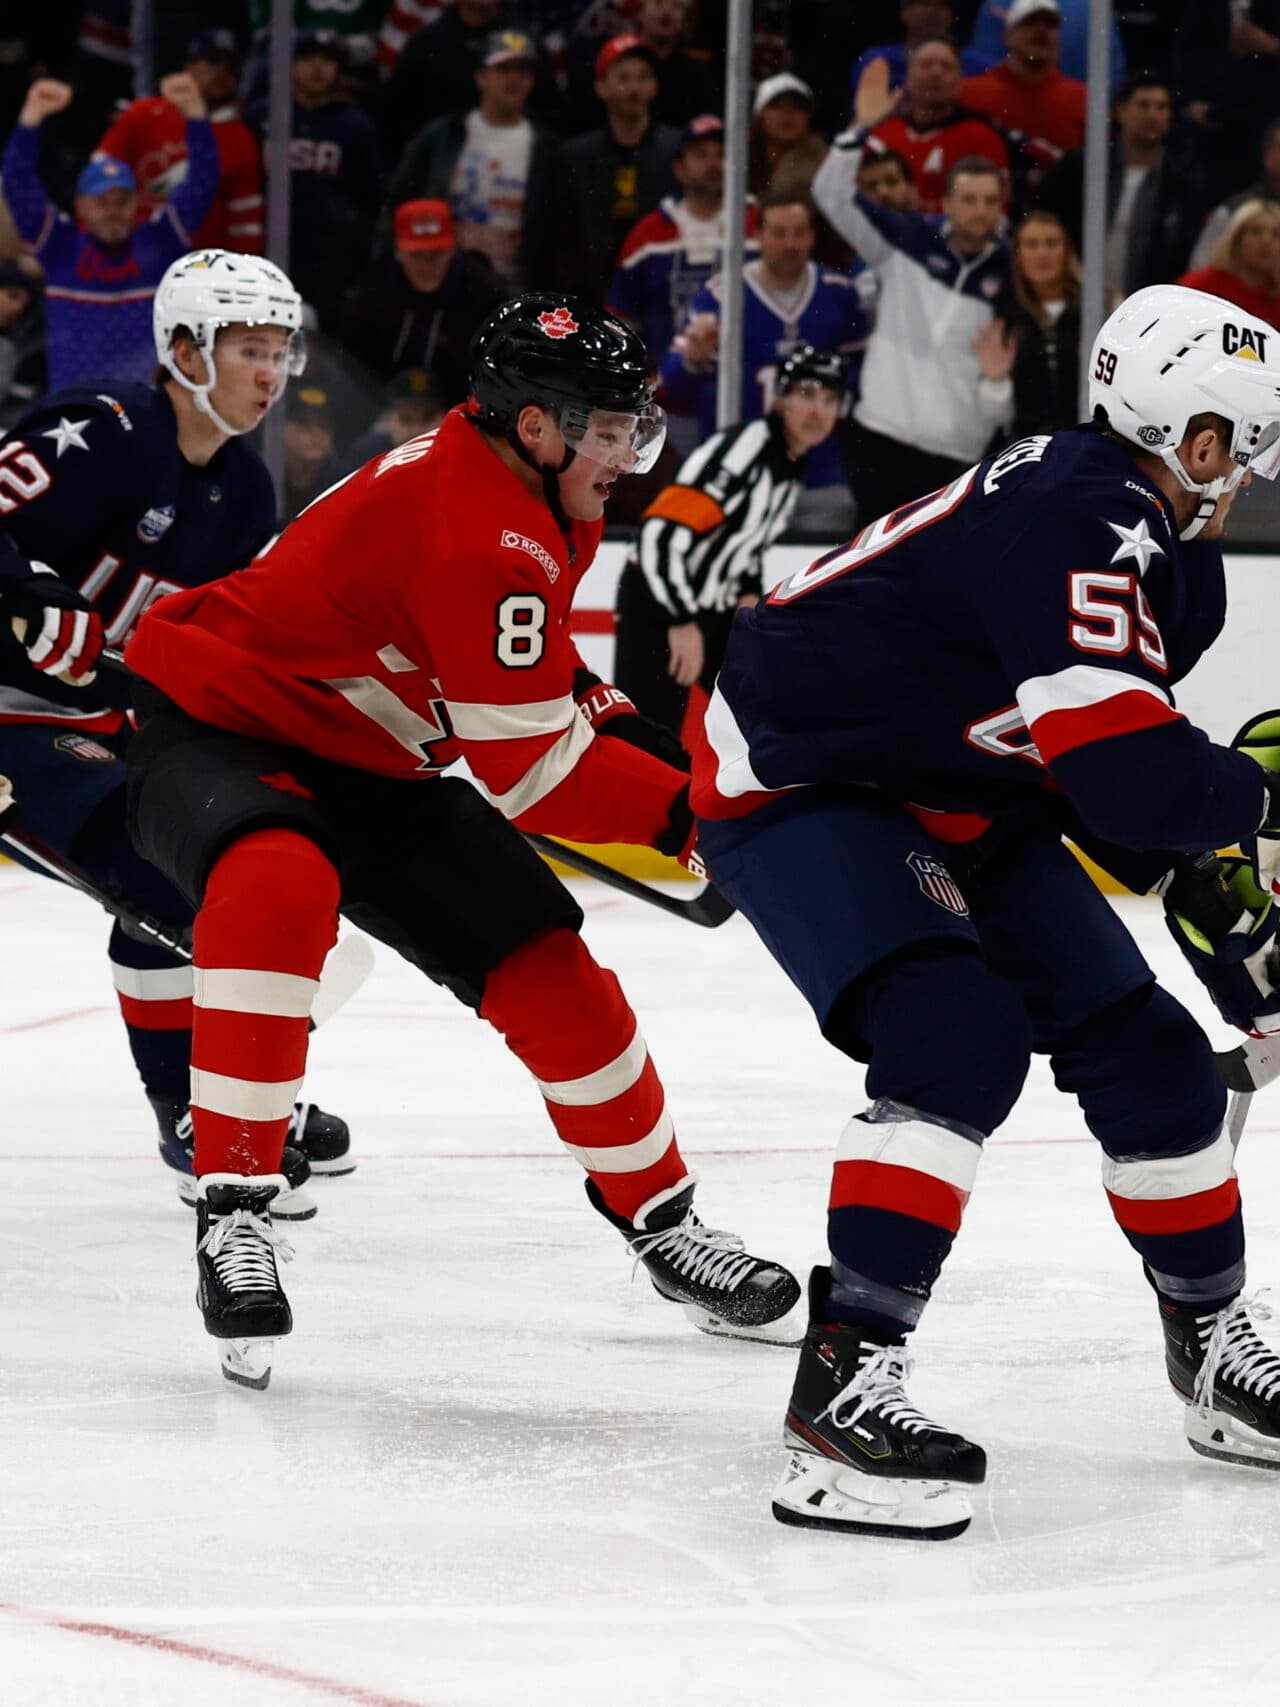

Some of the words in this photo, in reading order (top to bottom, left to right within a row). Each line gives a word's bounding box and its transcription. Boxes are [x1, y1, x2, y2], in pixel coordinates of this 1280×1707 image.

[1223, 322, 1267, 363] CAT
[1094, 347, 1118, 386] 59
[521, 539, 559, 580] ROGERS
[495, 592, 548, 670] 8
[1067, 570, 1170, 676] 59
